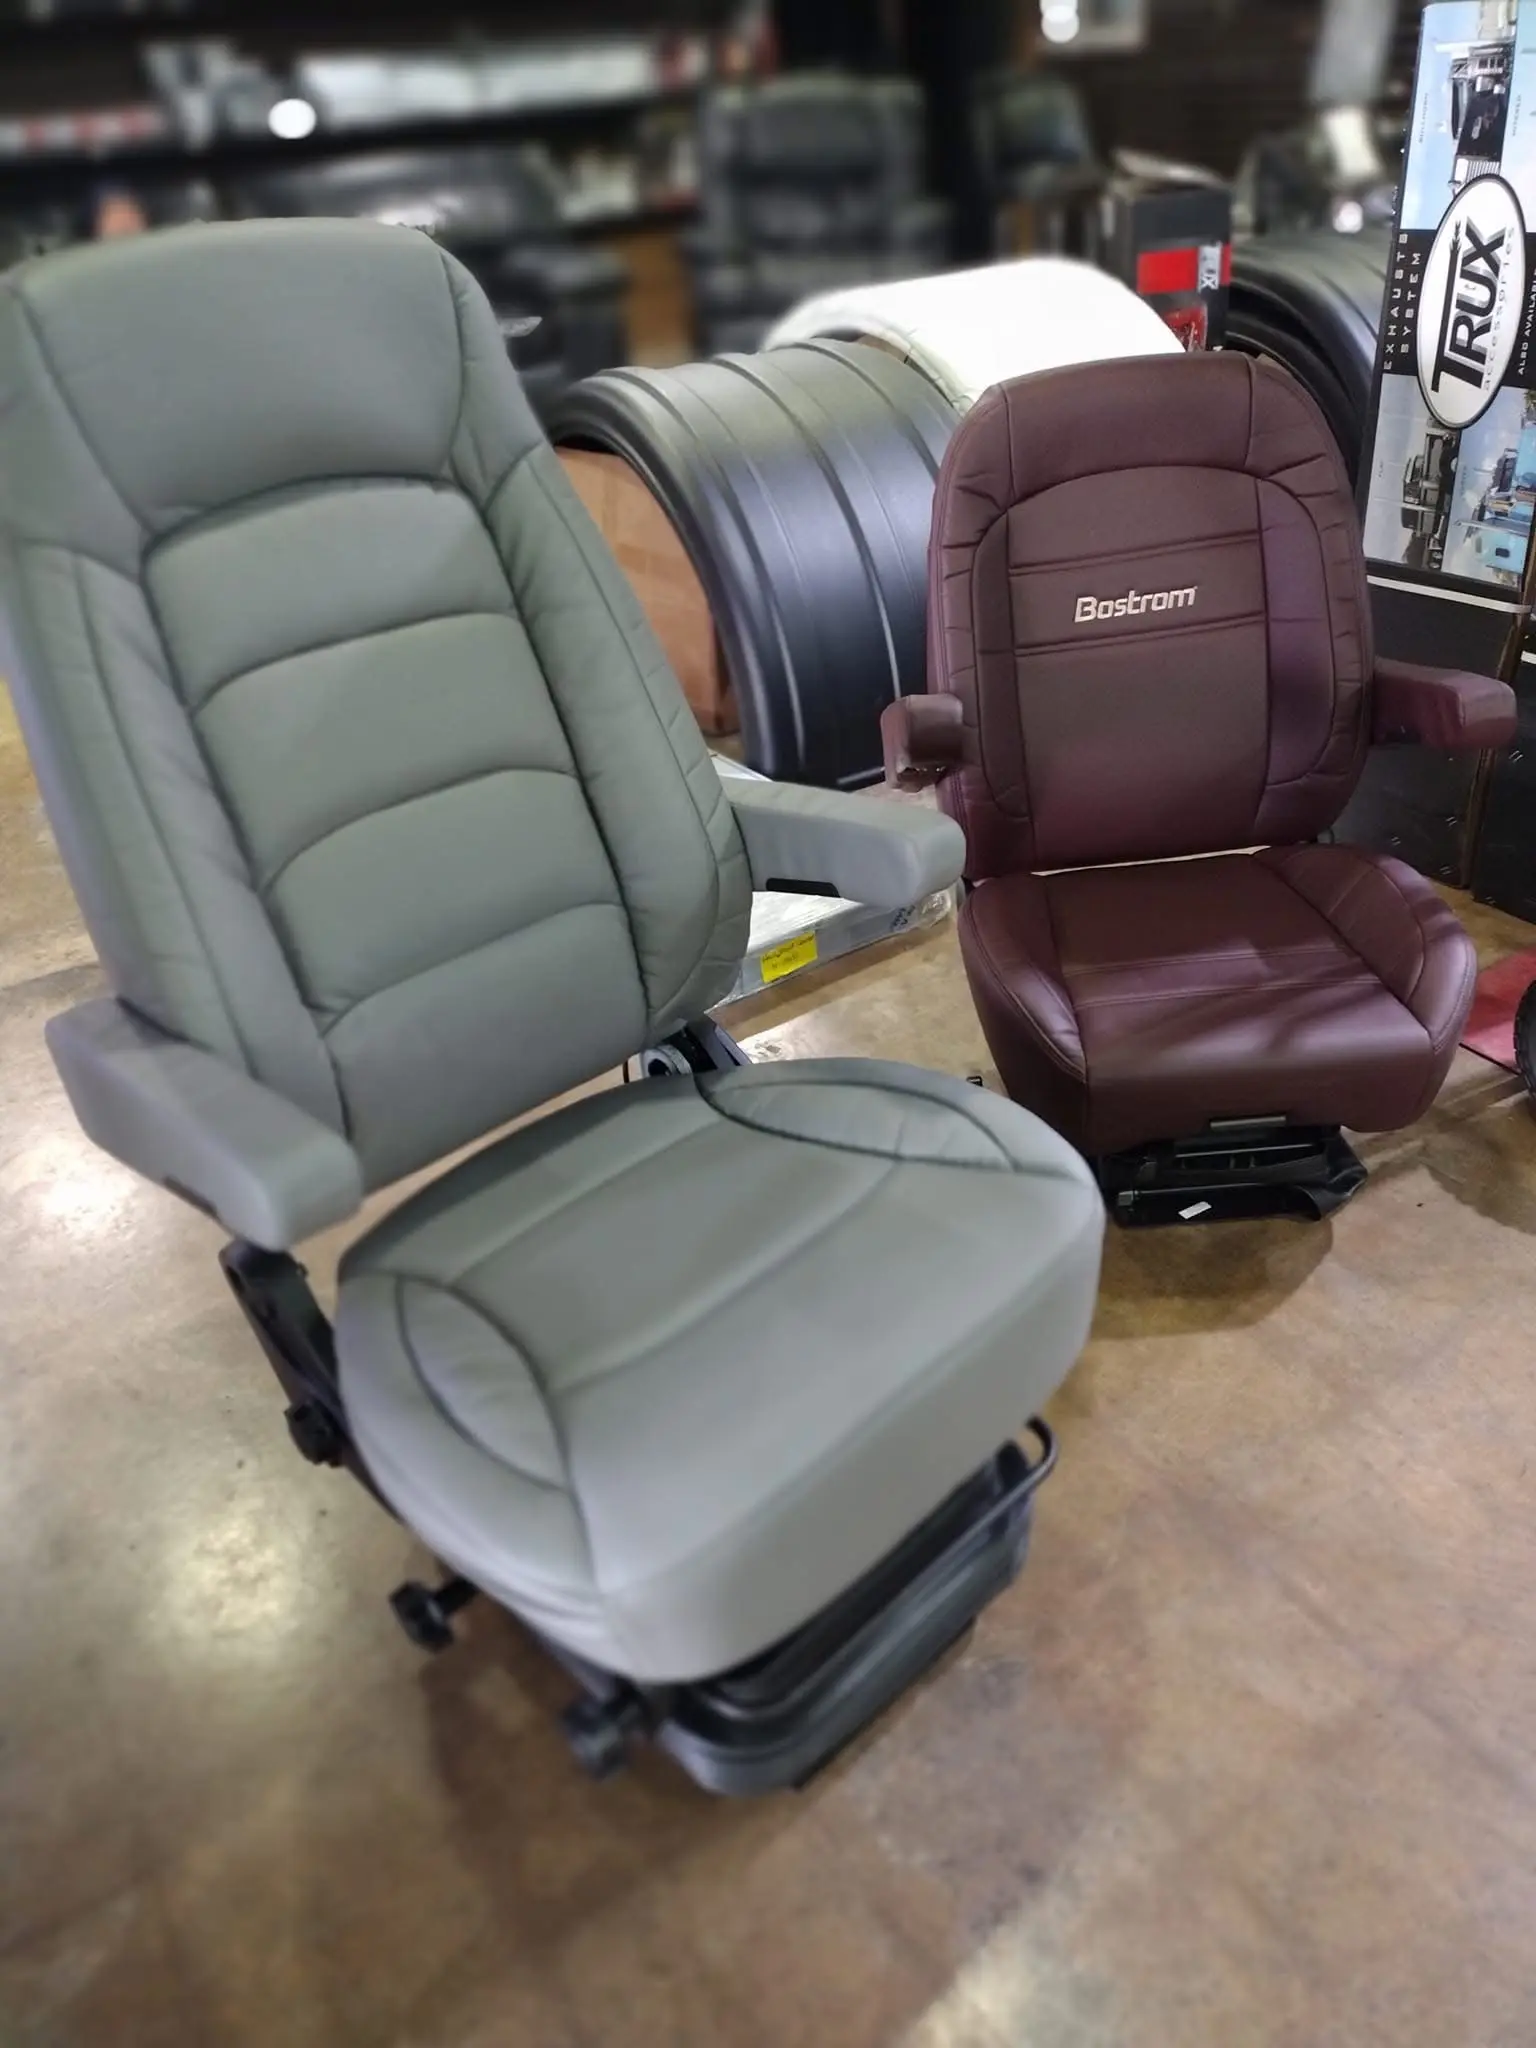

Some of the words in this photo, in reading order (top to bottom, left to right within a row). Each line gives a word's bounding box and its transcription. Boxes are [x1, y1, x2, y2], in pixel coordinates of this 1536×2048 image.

[1198, 240, 1223, 293] UX
[1383, 233, 1408, 370] EXHAUSTS
[1400, 252, 1421, 354] SYSTEM
[1431, 216, 1506, 393] TRUX
[1484, 226, 1515, 392] accessories
[1518, 342, 1529, 375] ALSO
[1524, 268, 1536, 337] AVAILAB
[1074, 587, 1198, 623] Bostrom
